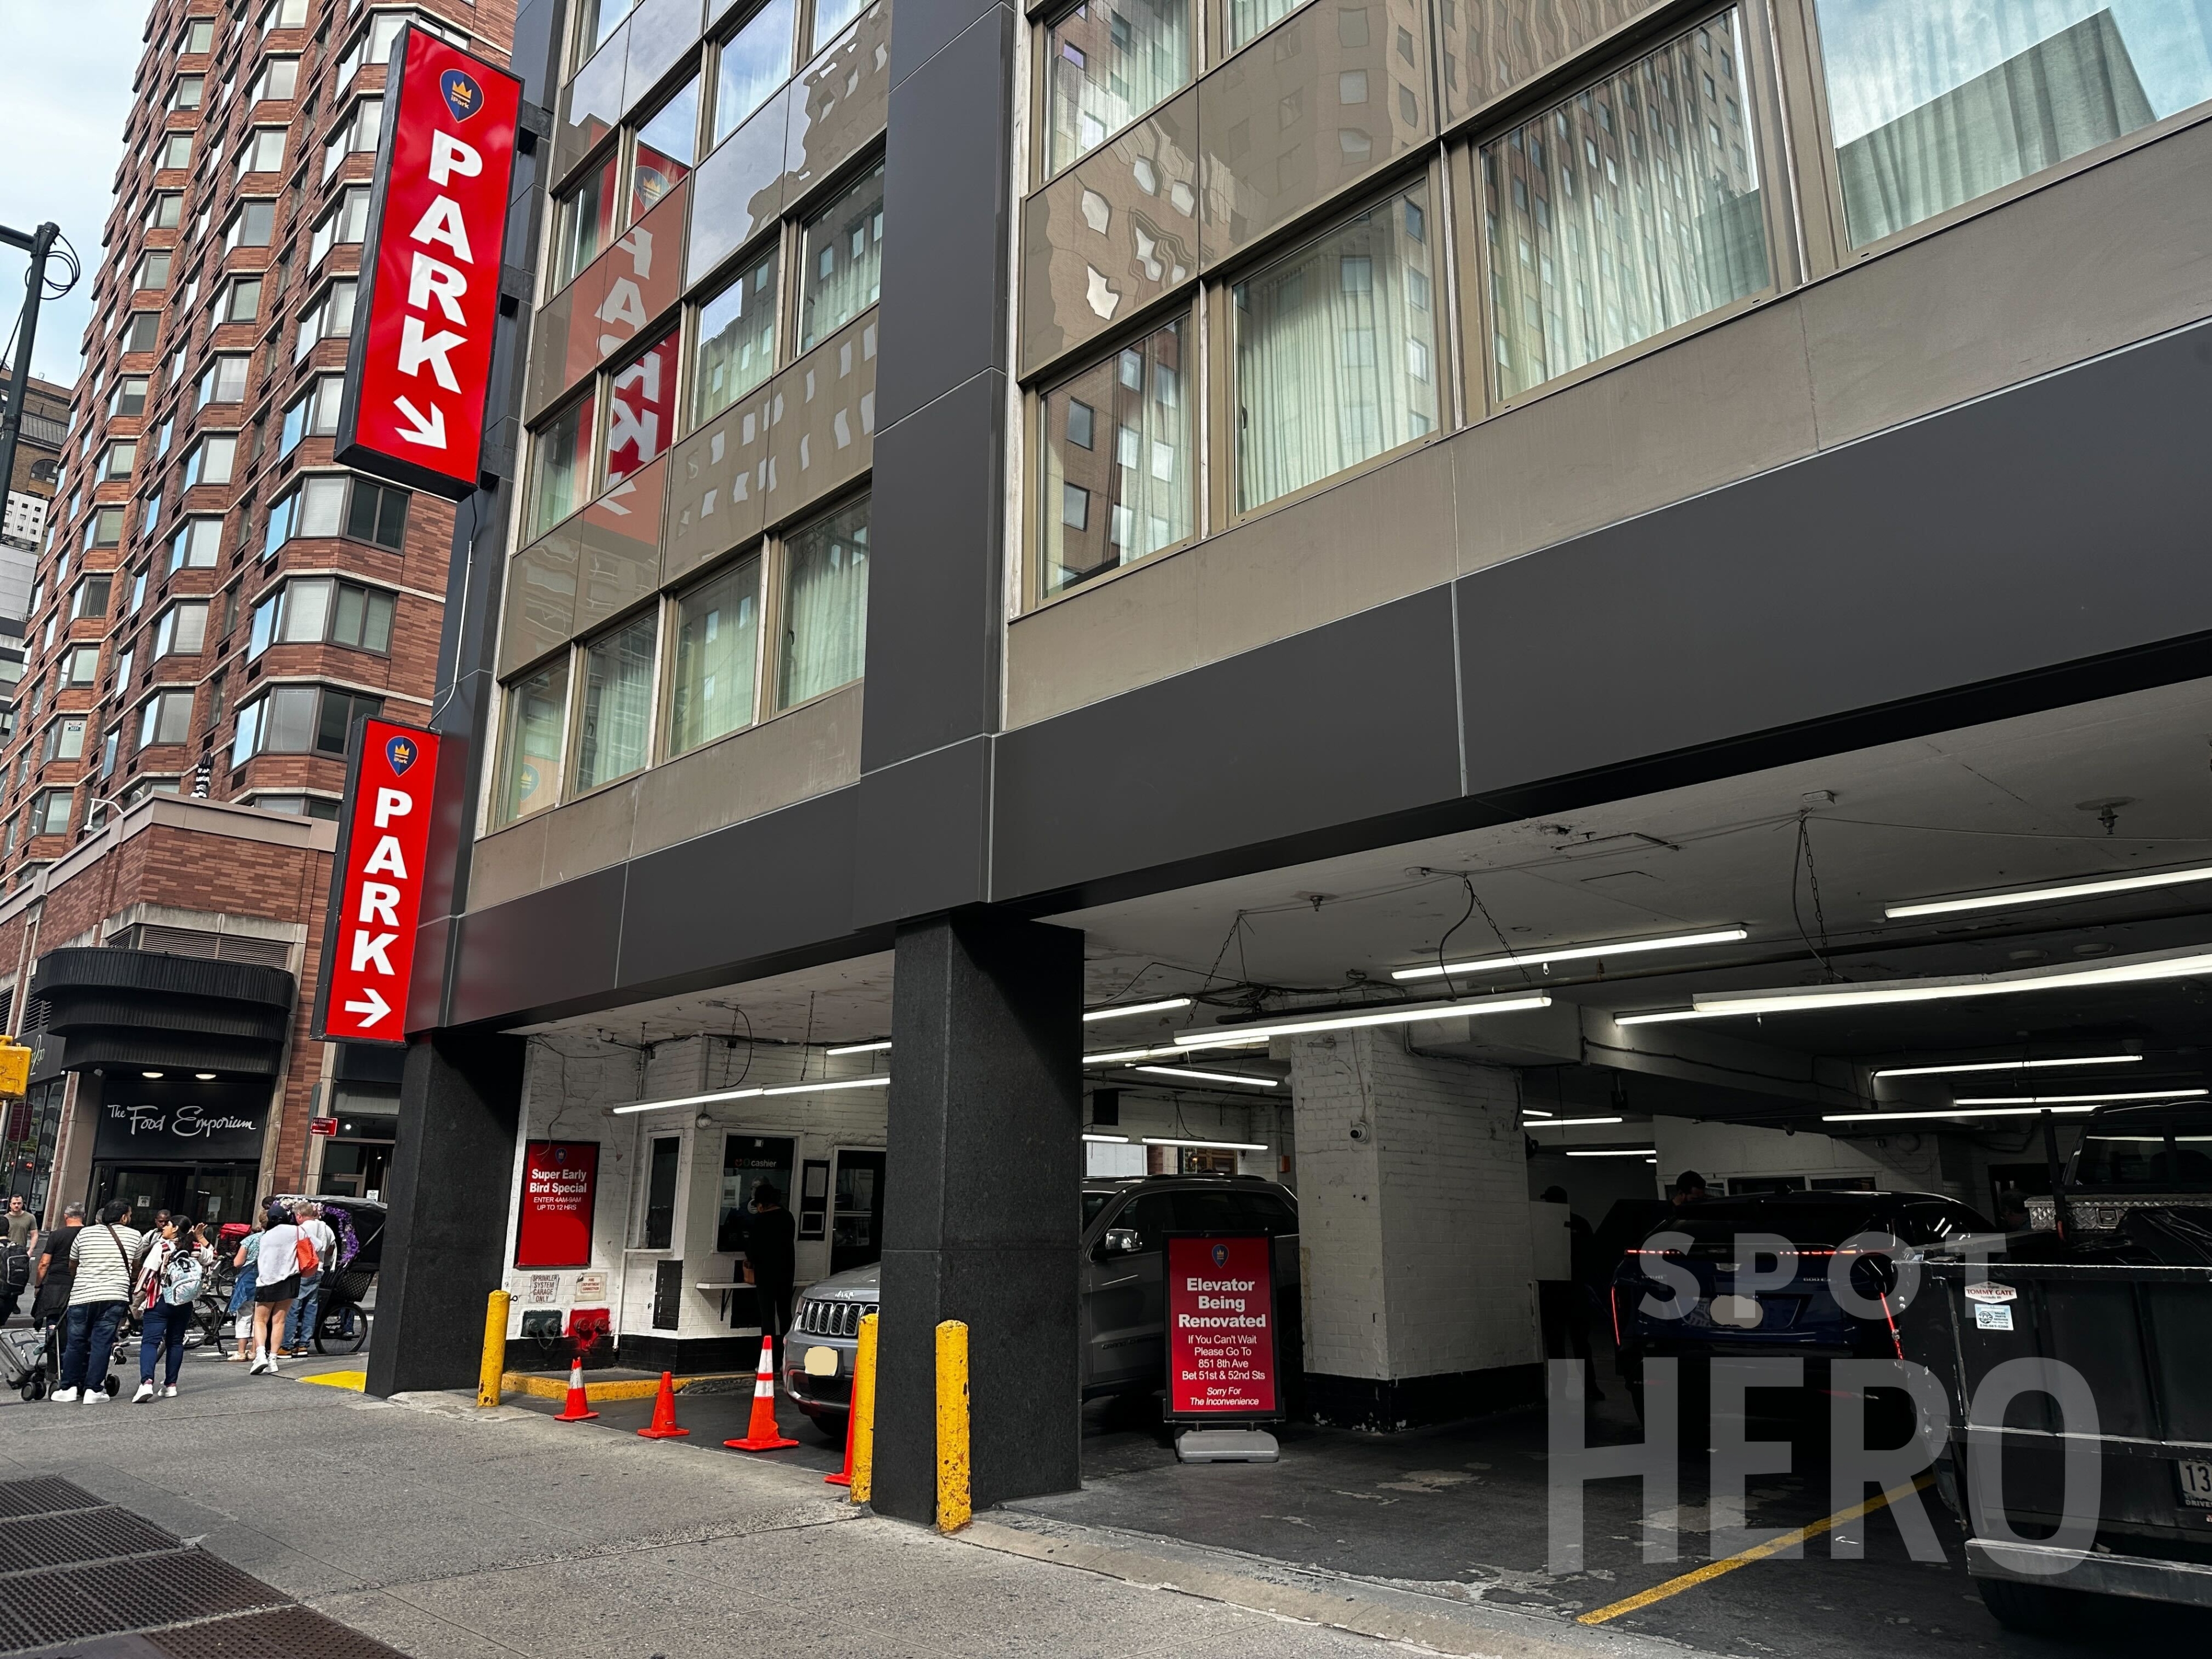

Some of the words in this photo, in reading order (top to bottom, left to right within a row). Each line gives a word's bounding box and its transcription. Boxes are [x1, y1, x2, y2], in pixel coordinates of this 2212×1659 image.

[450, 94, 469, 109] iPark
[397, 128, 482, 395] PARK
[350, 787, 412, 975] PARK
[107, 1104, 126, 1118] The
[126, 1105, 166, 1135] Food
[172, 1105, 257, 1137] Emporium
[751, 1159, 777, 1167] cashier
[532, 1168, 560, 1181] Super
[562, 1169, 587, 1182] Early
[529, 1182, 550, 1193] Bird
[552, 1183, 587, 1195] Special
[1187, 1278, 1255, 1291] Elevator
[1198, 1296, 1245, 1312] Being
[1179, 1314, 1266, 1328] Renovated
[1188, 1335, 1194, 1344] If
[1195, 1335, 1211, 1344] You
[1214, 1335, 1236, 1344] Can't
[1237, 1335, 1257, 1344] Wait
[1194, 1347, 1224, 1356] Please
[1226, 1347, 1239, 1356] Go
[1241, 1347, 1252, 1356] To
[1198, 1359, 1214, 1368] 851
[1217, 1359, 1230, 1368] 8th
[1232, 1359, 1249, 1368] Ave
[1182, 1370, 1197, 1380] Bet
[1199, 1370, 1217, 1380] 51st
[1219, 1370, 1226, 1380] &
[1228, 1370, 1249, 1380] 52nd
[1252, 1370, 1266, 1380] Sts
[1207, 1387, 1227, 1397] Sorry
[1228, 1387, 1242, 1395] For
[1190, 1397, 1205, 1406] The
[1206, 1397, 1259, 1406] Inconvenience
